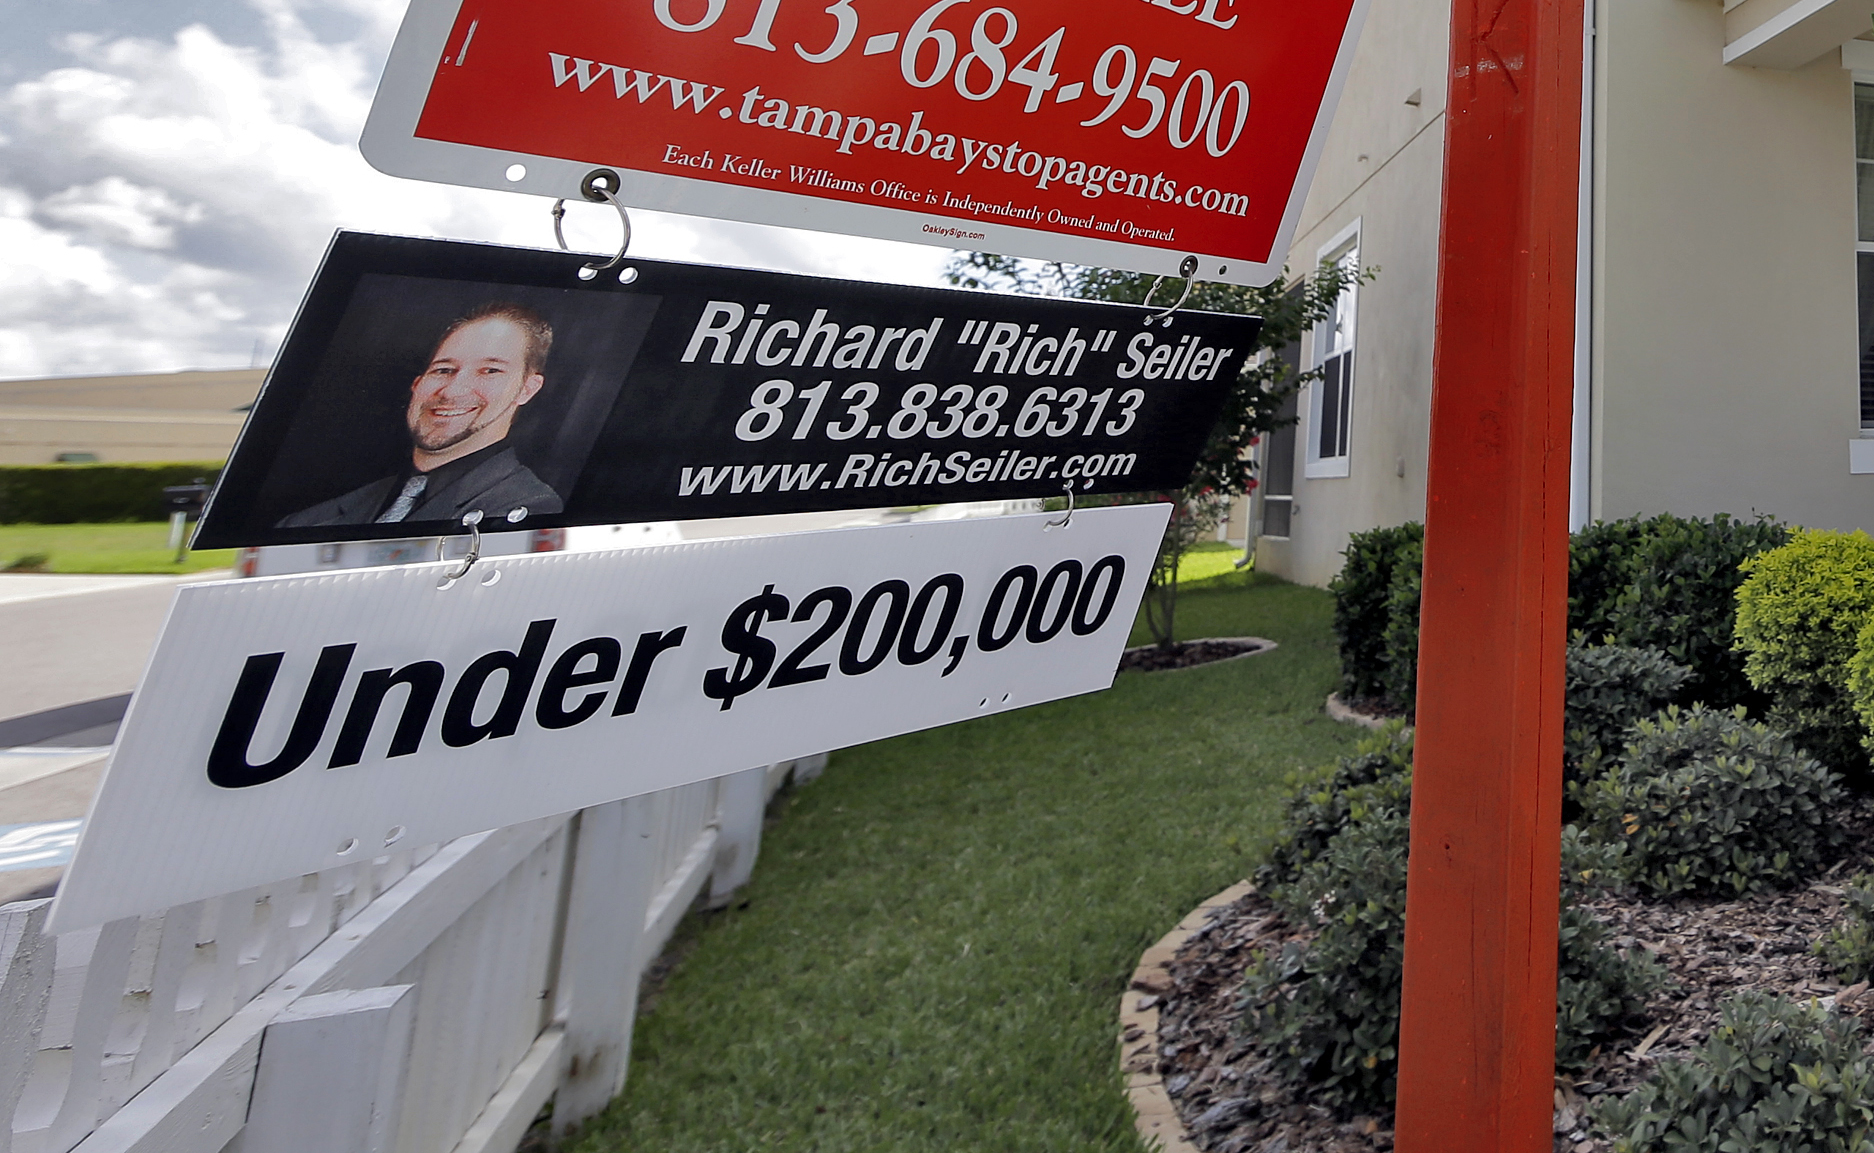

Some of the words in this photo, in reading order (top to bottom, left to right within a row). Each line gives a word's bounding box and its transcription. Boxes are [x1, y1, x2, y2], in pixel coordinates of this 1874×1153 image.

[548, 52, 1249, 217] www.tampabaystopagents.com
[660, 143, 714, 170] Each
[719, 153, 782, 180] Keller
[789, 164, 866, 194] Williams
[870, 179, 921, 202] Office
[924, 189, 938, 205] is
[942, 190, 1045, 224] Independently
[1047, 208, 1095, 230] Owned
[1095, 218, 1120, 234] and
[1121, 220, 1176, 243] Operated.
[922, 223, 985, 241] OakleySign.com
[681, 301, 942, 372] Richard
[958, 320, 1114, 377] "Rich"
[1117, 333, 1234, 381] Seiler
[735, 380, 1144, 442] 813.838.6313
[679, 449, 1136, 497] www.RichSeiler.com
[207, 619, 685, 789] Under
[703, 555, 1126, 709] $200,000
